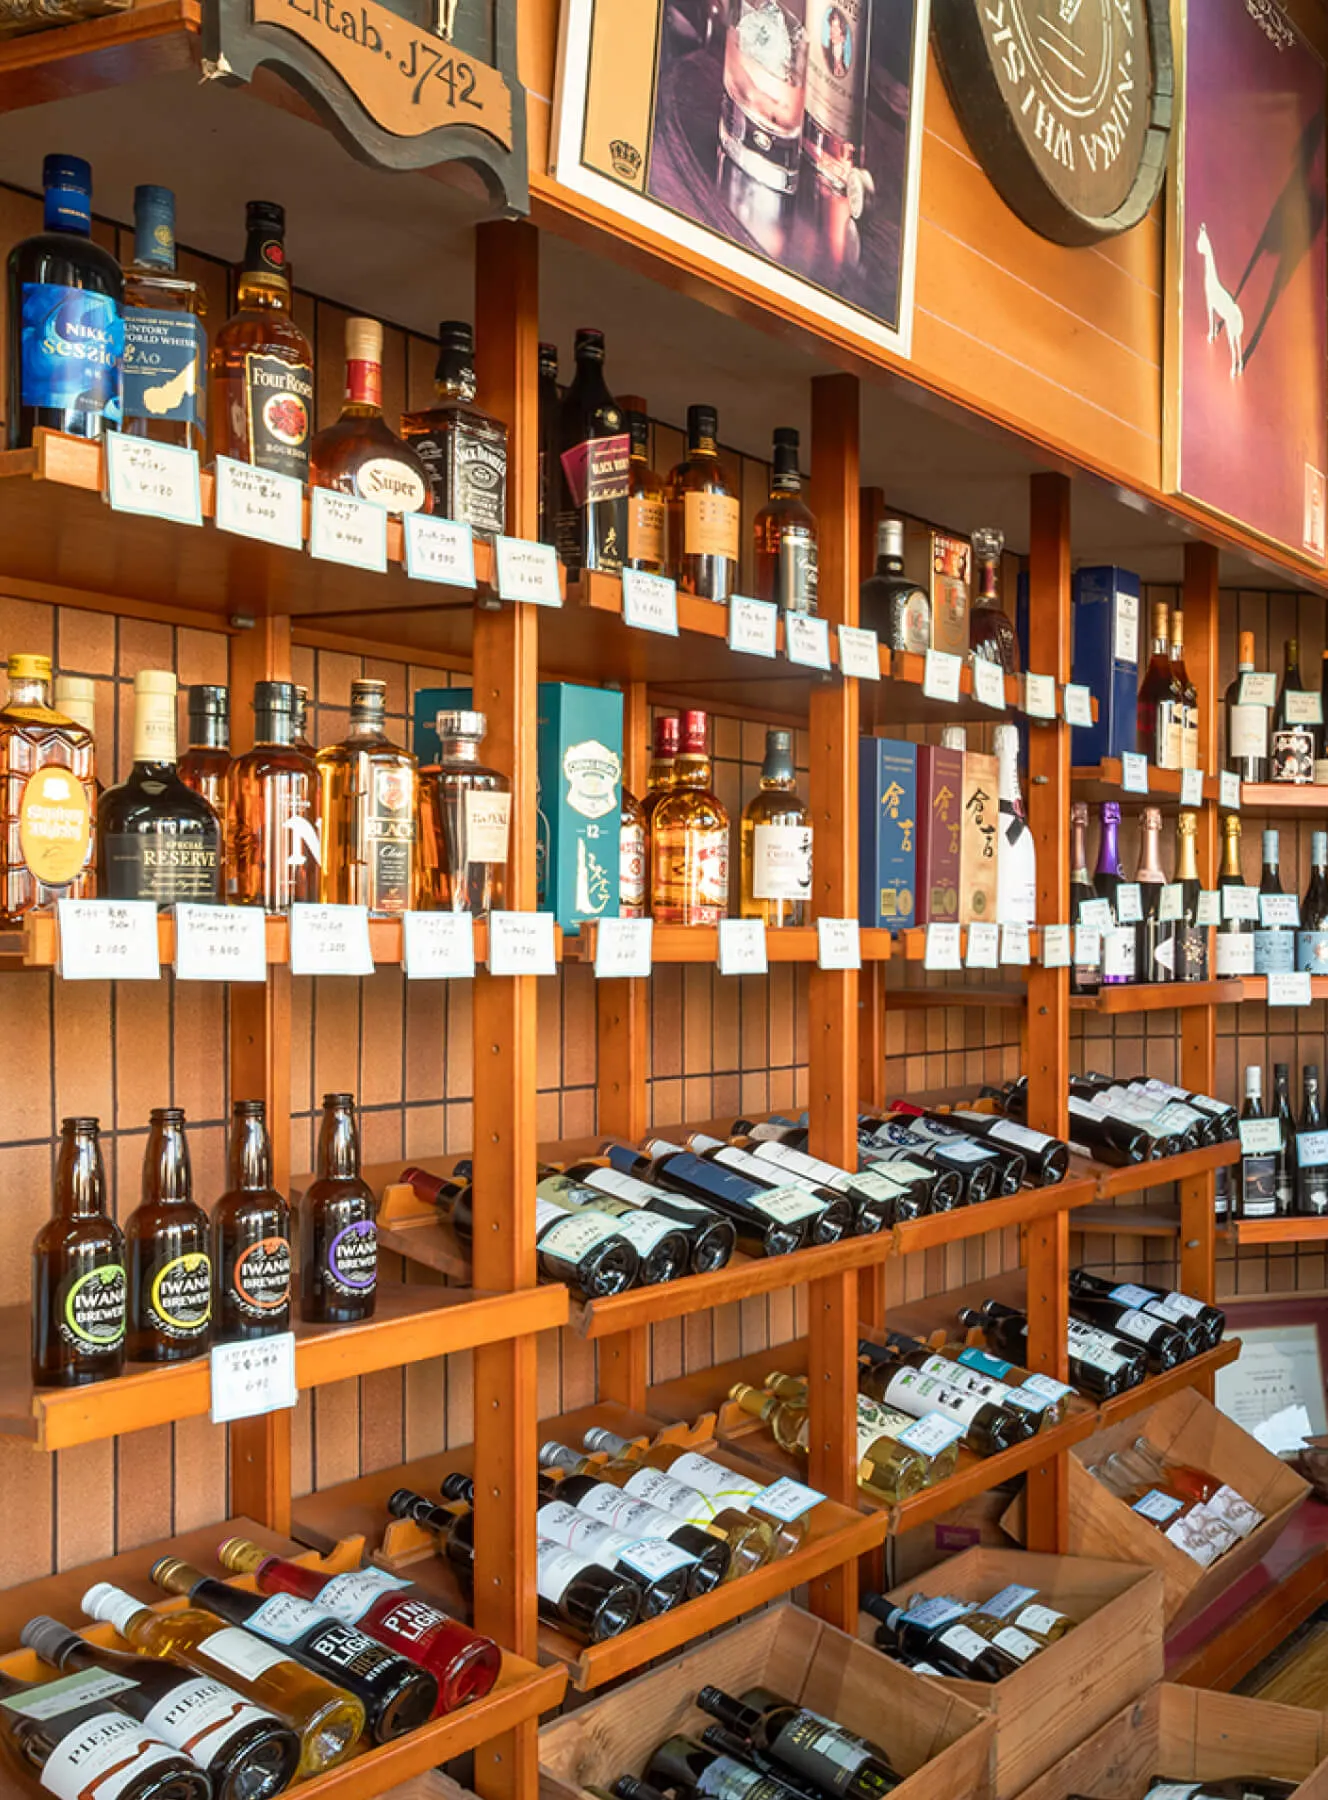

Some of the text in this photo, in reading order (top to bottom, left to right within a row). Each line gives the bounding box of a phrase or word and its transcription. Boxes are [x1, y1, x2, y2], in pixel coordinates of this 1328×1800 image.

[1078, 62, 1135, 172] NIKKA
[253, 367, 286, 389] Four
[368, 469, 417, 497] Super
[881, 781, 914, 852] 倉吉
[966, 788, 996, 858] 倉吉
[586, 824, 600, 838] 12
[143, 850, 217, 867] RESERVE
